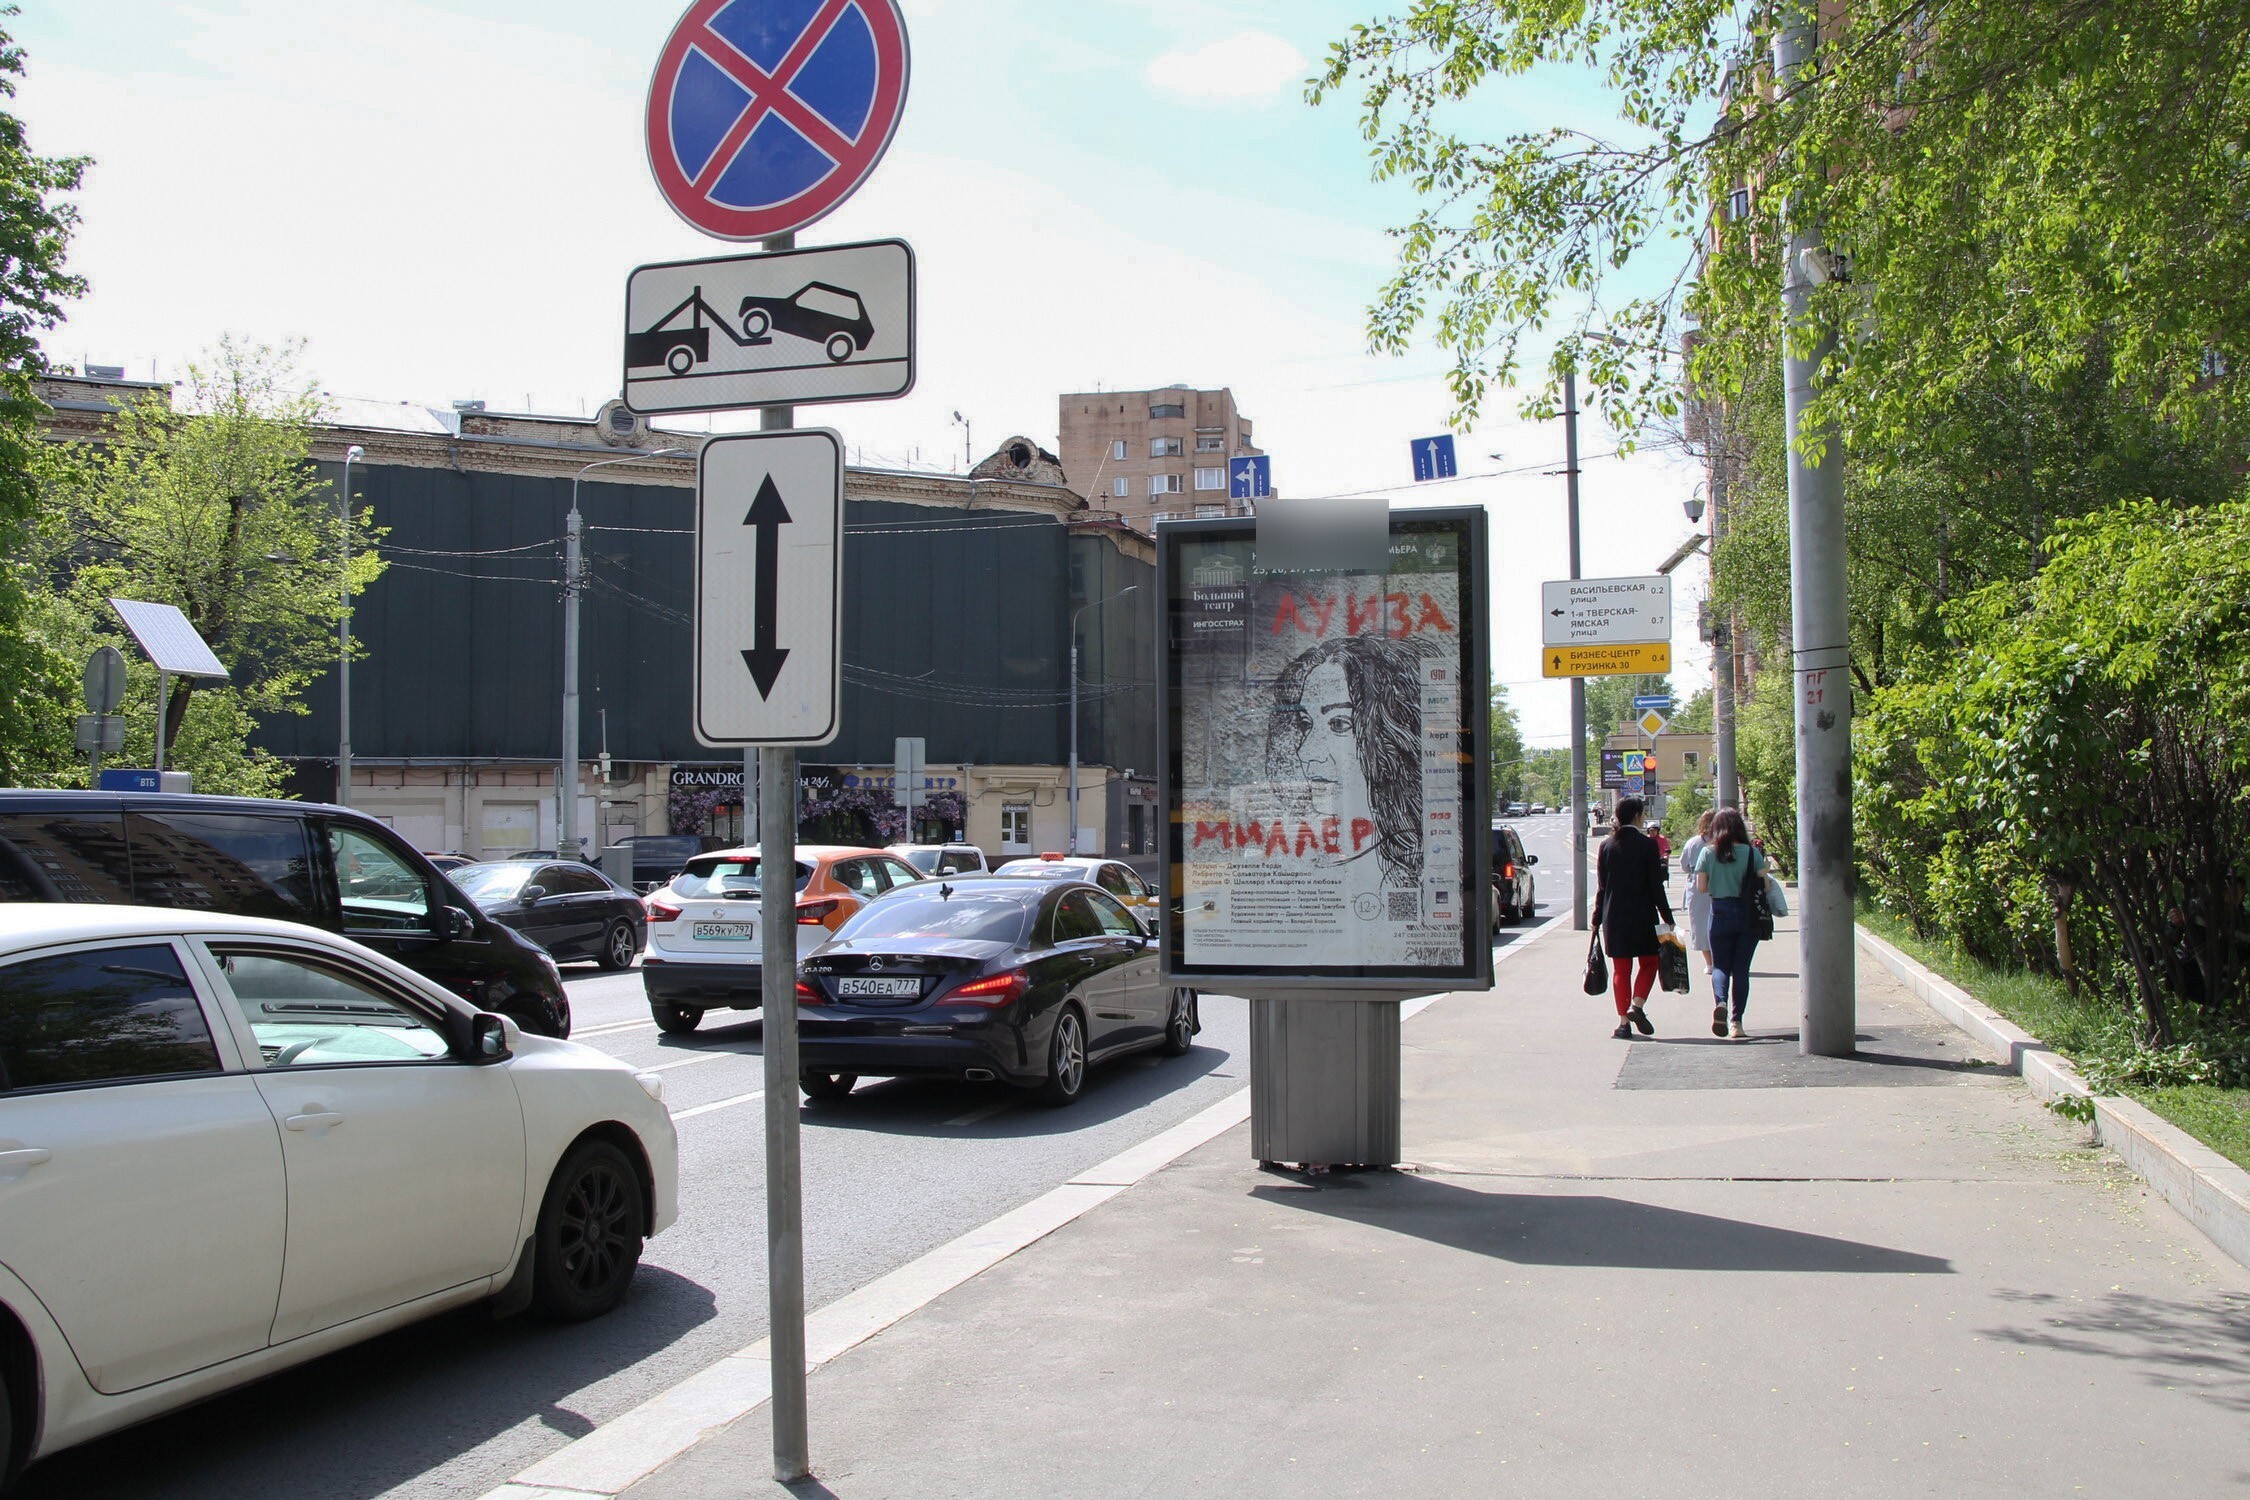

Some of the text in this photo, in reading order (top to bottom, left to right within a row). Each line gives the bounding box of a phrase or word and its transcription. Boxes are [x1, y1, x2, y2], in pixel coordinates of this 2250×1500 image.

[1570, 584, 1646, 595] ВАСИЛЬЕВСКАЯ
[1651, 586, 1664, 594] 0.2
[1193, 590, 1244, 601] Большой
[1570, 596, 1597, 604] улица
[1203, 601, 1234, 612] театр
[1271, 592, 1454, 639] ЛУИЗА
[1586, 607, 1638, 617] ТВЕРСКАЯ-
[1193, 619, 1244, 628] ИНГОССТРАХ
[1570, 619, 1610, 628] ЯМСКАЯ
[1651, 616, 1664, 624] 0.7
[1570, 630, 1598, 638] улица
[1570, 649, 1641, 660] БИЗНЕС-ЦЕНТР
[1652, 654, 1665, 662] 0.4
[1570, 662, 1617, 671] ГРУЗИНКА
[1807, 689, 1823, 704] 21
[1429, 732, 1449, 740] kept
[140, 777, 156, 787] ВТБ
[844, 775, 957, 788] ФОТОНТР
[1192, 818, 1375, 857] МИЛЛЕР
[1359, 901, 1377, 912] 12+
[735, 925, 749, 934] 797
[896, 979, 917, 990] 777
